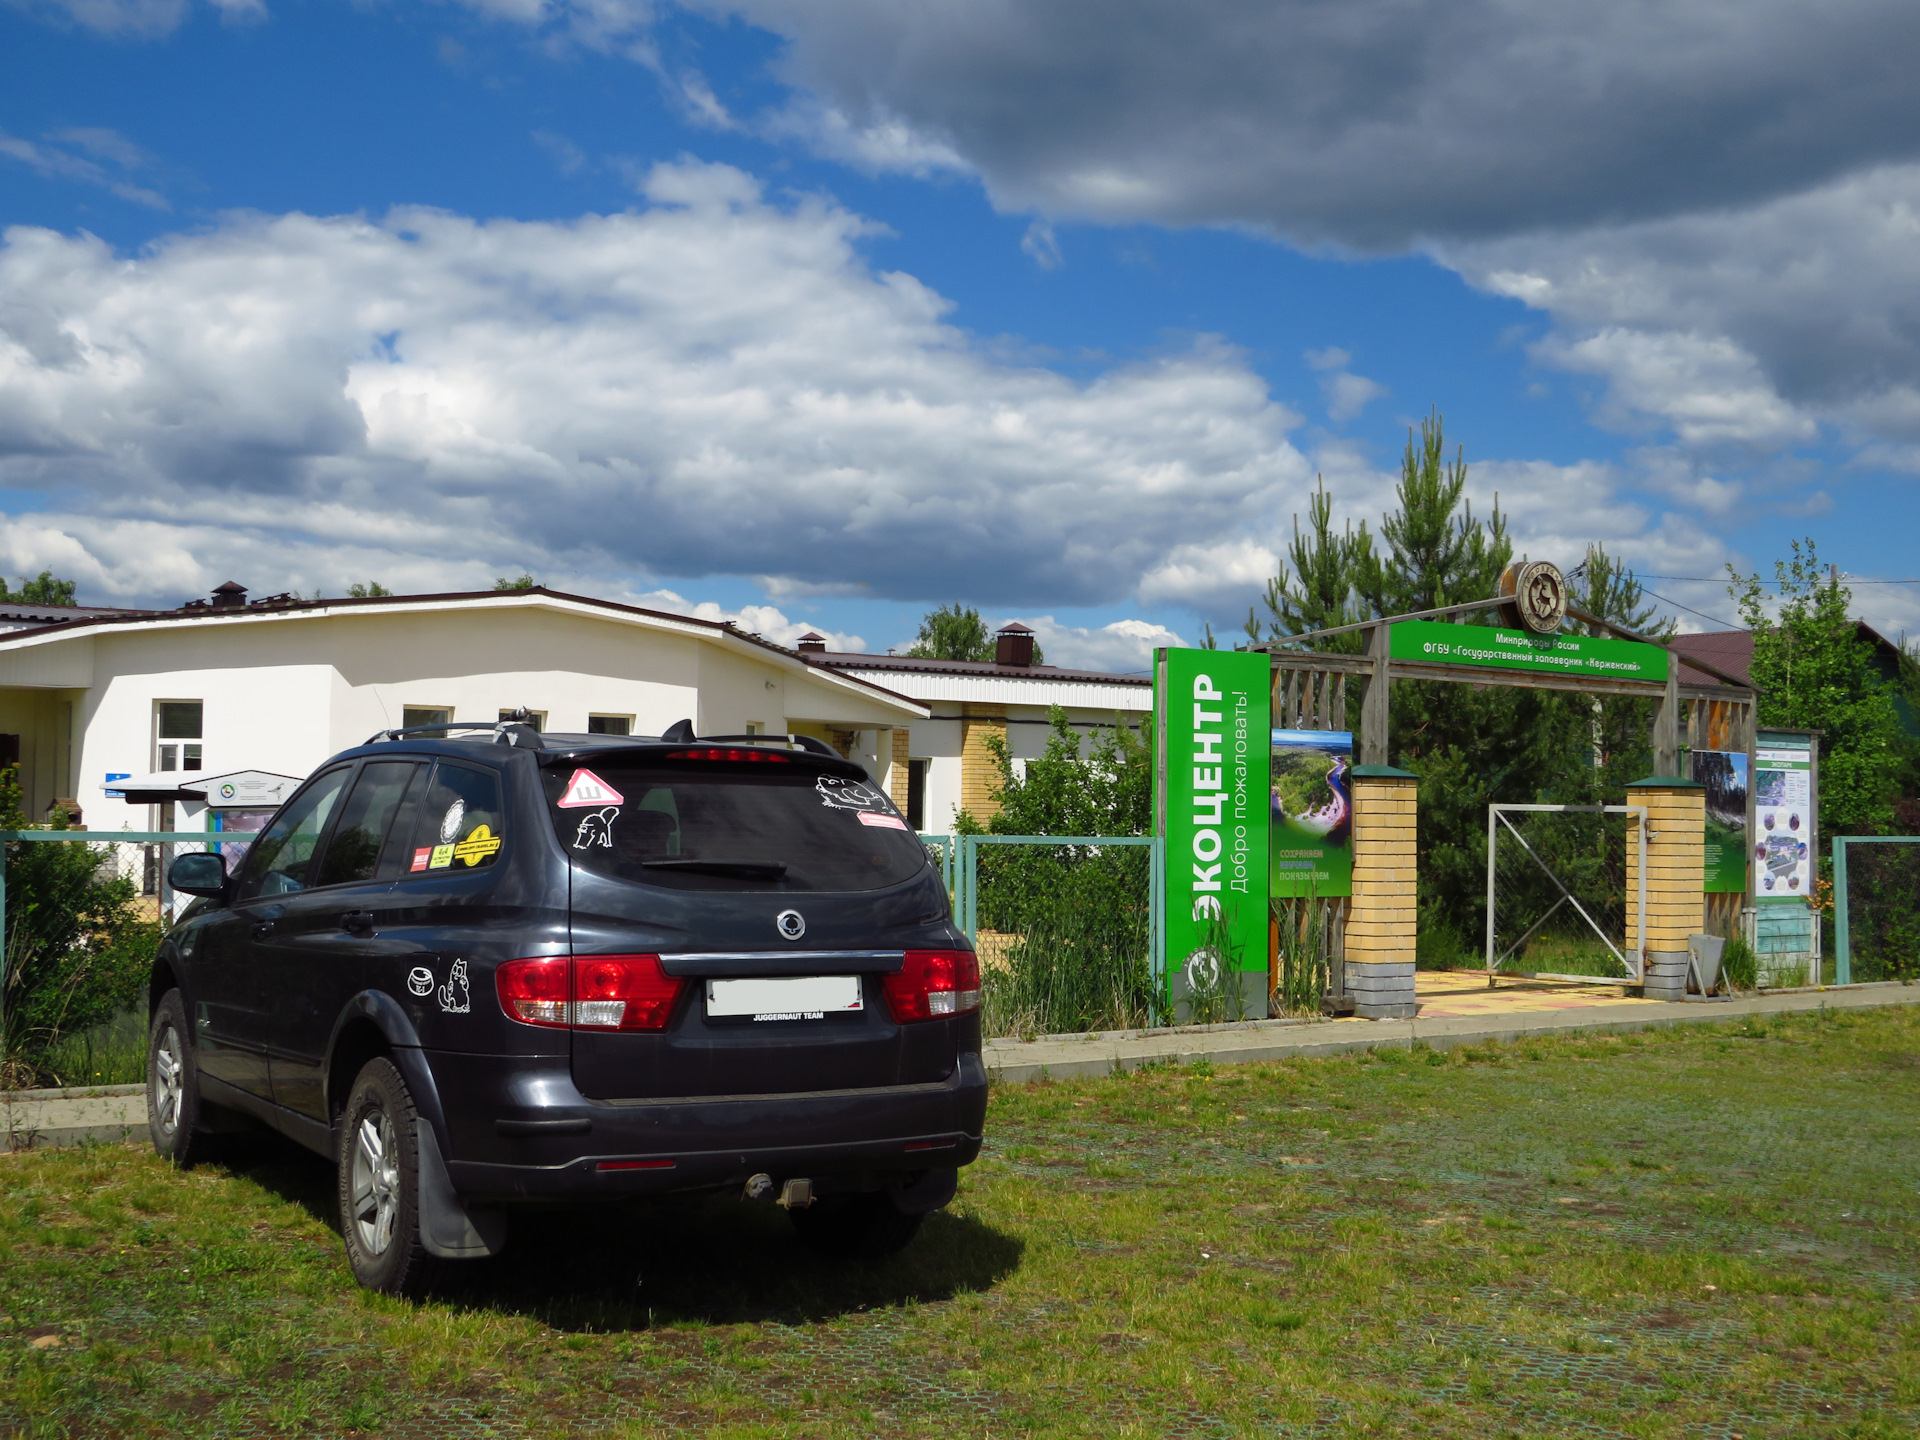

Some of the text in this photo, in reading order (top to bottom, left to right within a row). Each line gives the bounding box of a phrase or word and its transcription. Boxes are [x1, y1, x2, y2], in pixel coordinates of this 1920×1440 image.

[1495, 633, 1580, 650] Минприроды России
[1423, 642, 1641, 671] ФГБУ «Государственный заповедник «Керженский»
[1193, 674, 1228, 921] ЭКОЦЕНТР
[1230, 691, 1250, 893] Добро пожаловать!
[753, 1012, 824, 1021] JUGGERNAUT TEAM
